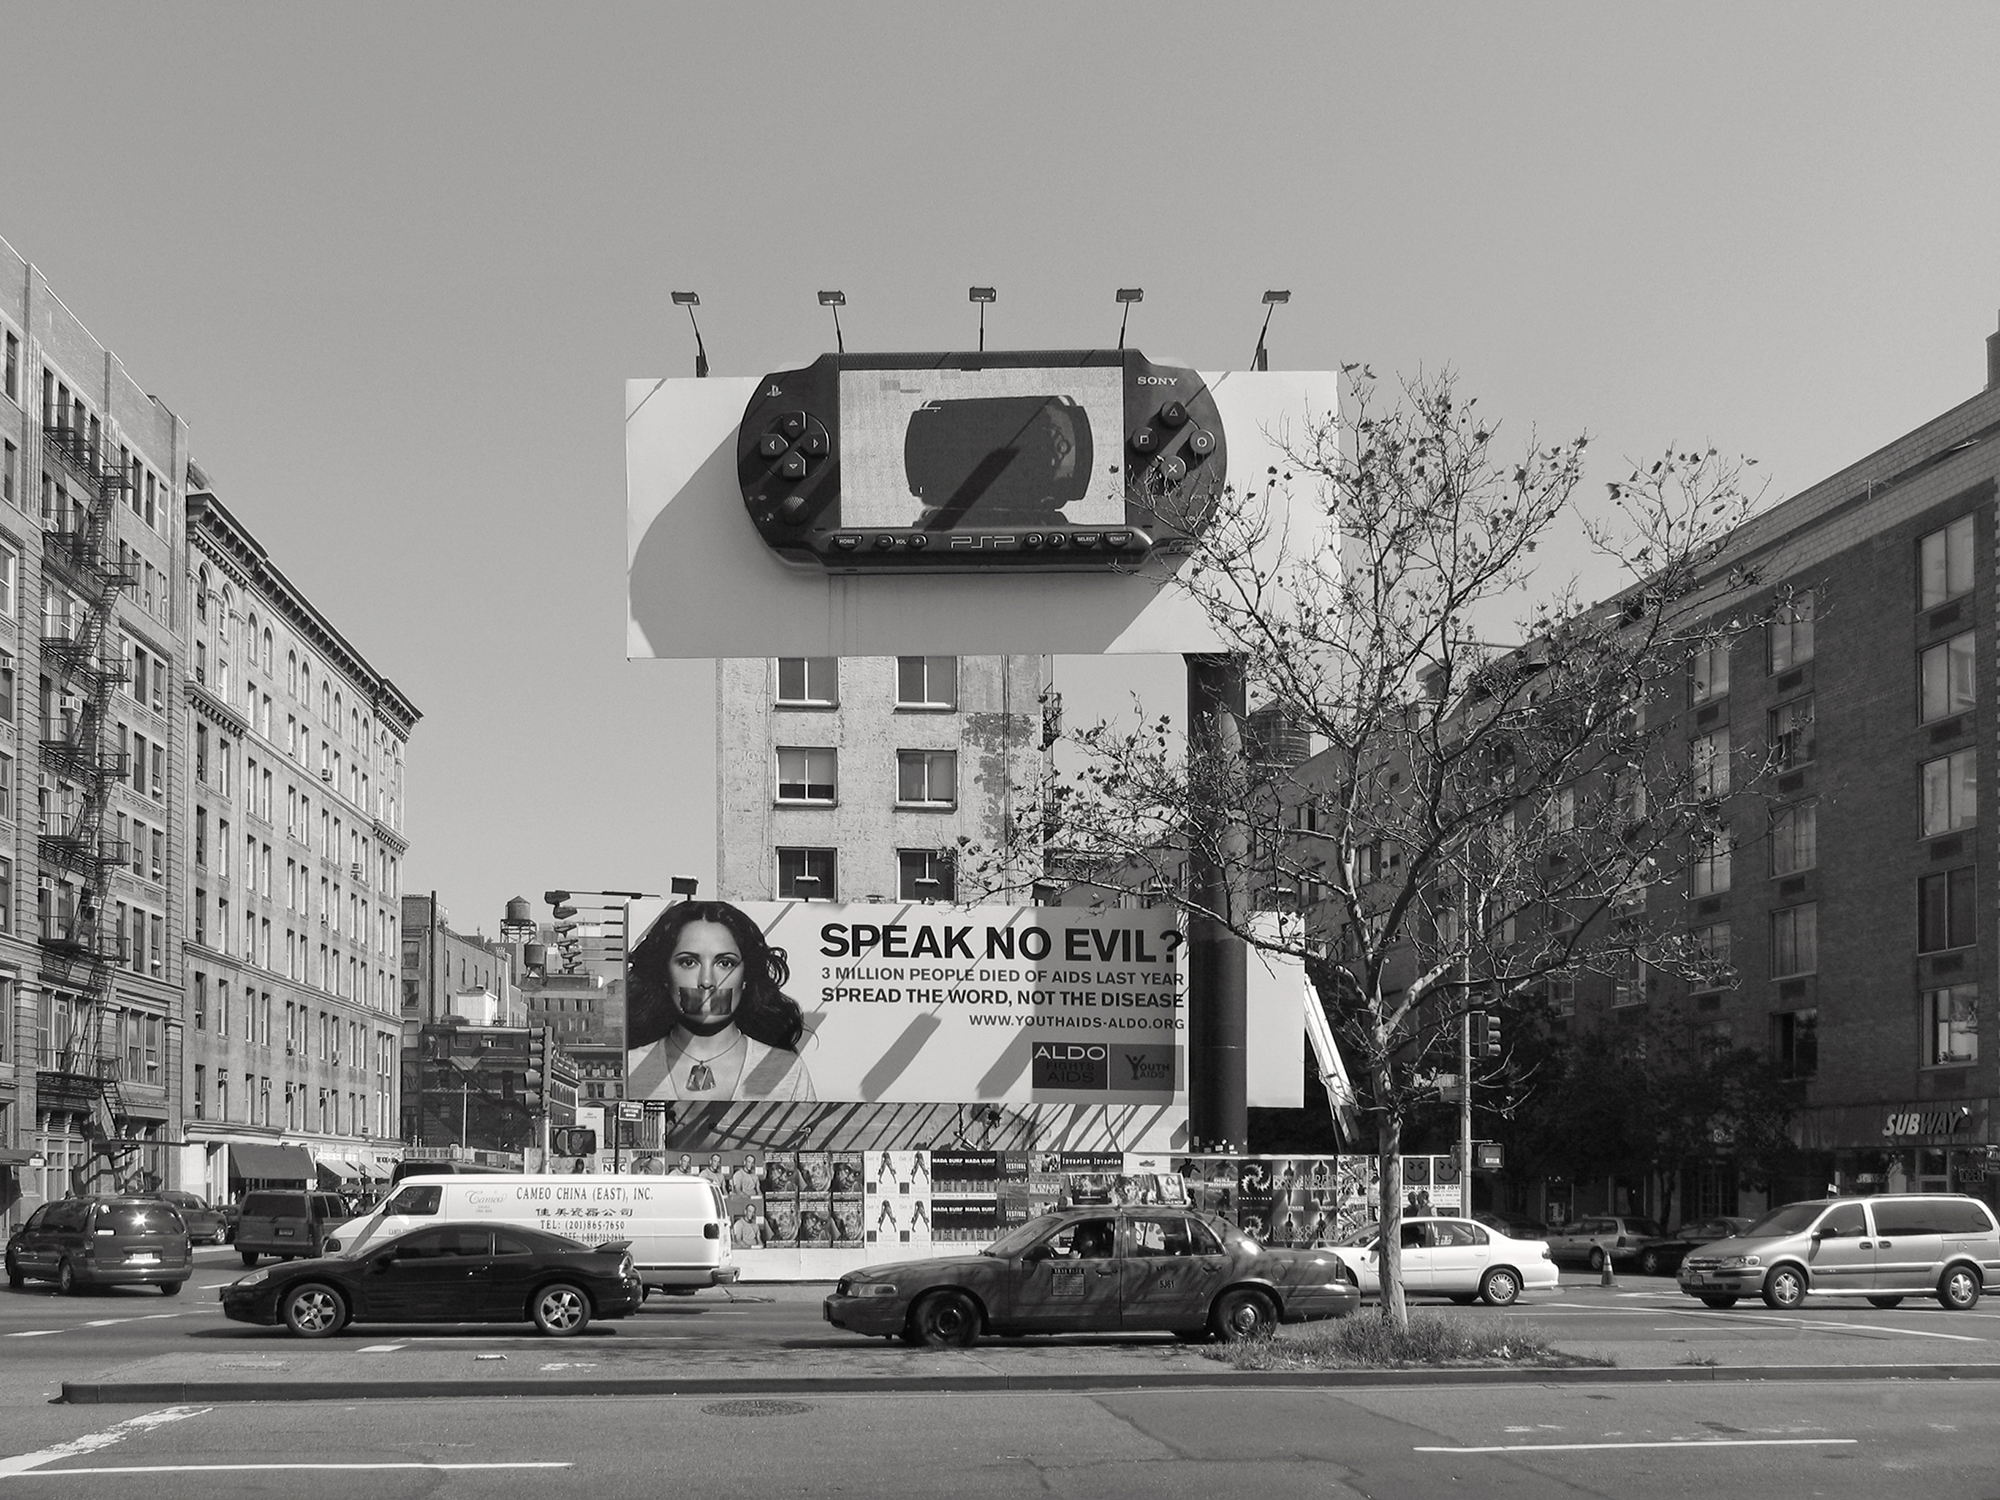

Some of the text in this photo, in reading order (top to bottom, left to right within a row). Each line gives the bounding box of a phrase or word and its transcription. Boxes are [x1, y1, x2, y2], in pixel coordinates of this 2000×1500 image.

[1137, 376, 1178, 386] SONY
[951, 536, 1015, 549] PSP
[820, 923, 1184, 963] SPEAK NO EVIL?
[821, 967, 1184, 986] 3 MILLION PEOPLE DIED OF AIDS LAST YEAR
[821, 987, 1185, 1008] SPREAD THE WORD, NOT THE DISEASE
[969, 1014, 1185, 1030] WWW.YOUTHAIDS-ALDO.ORG
[1034, 1045, 1106, 1061] ALDO
[1046, 1061, 1095, 1071] FIGHTS
[1046, 1072, 1095, 1083] AIDS
[1140, 1071, 1165, 1079] AIDS
[1882, 1111, 1966, 1136] SUBWAY
[603, 1163, 626, 1172] NC
[464, 1189, 508, 1205] Cameo
[516, 1187, 654, 1203] CAMEO CHINA (EAST), INC.
[535, 1207, 634, 1218] 佳美瓷器公司
[540, 1219, 625, 1231] TEL: (201)865-7650
